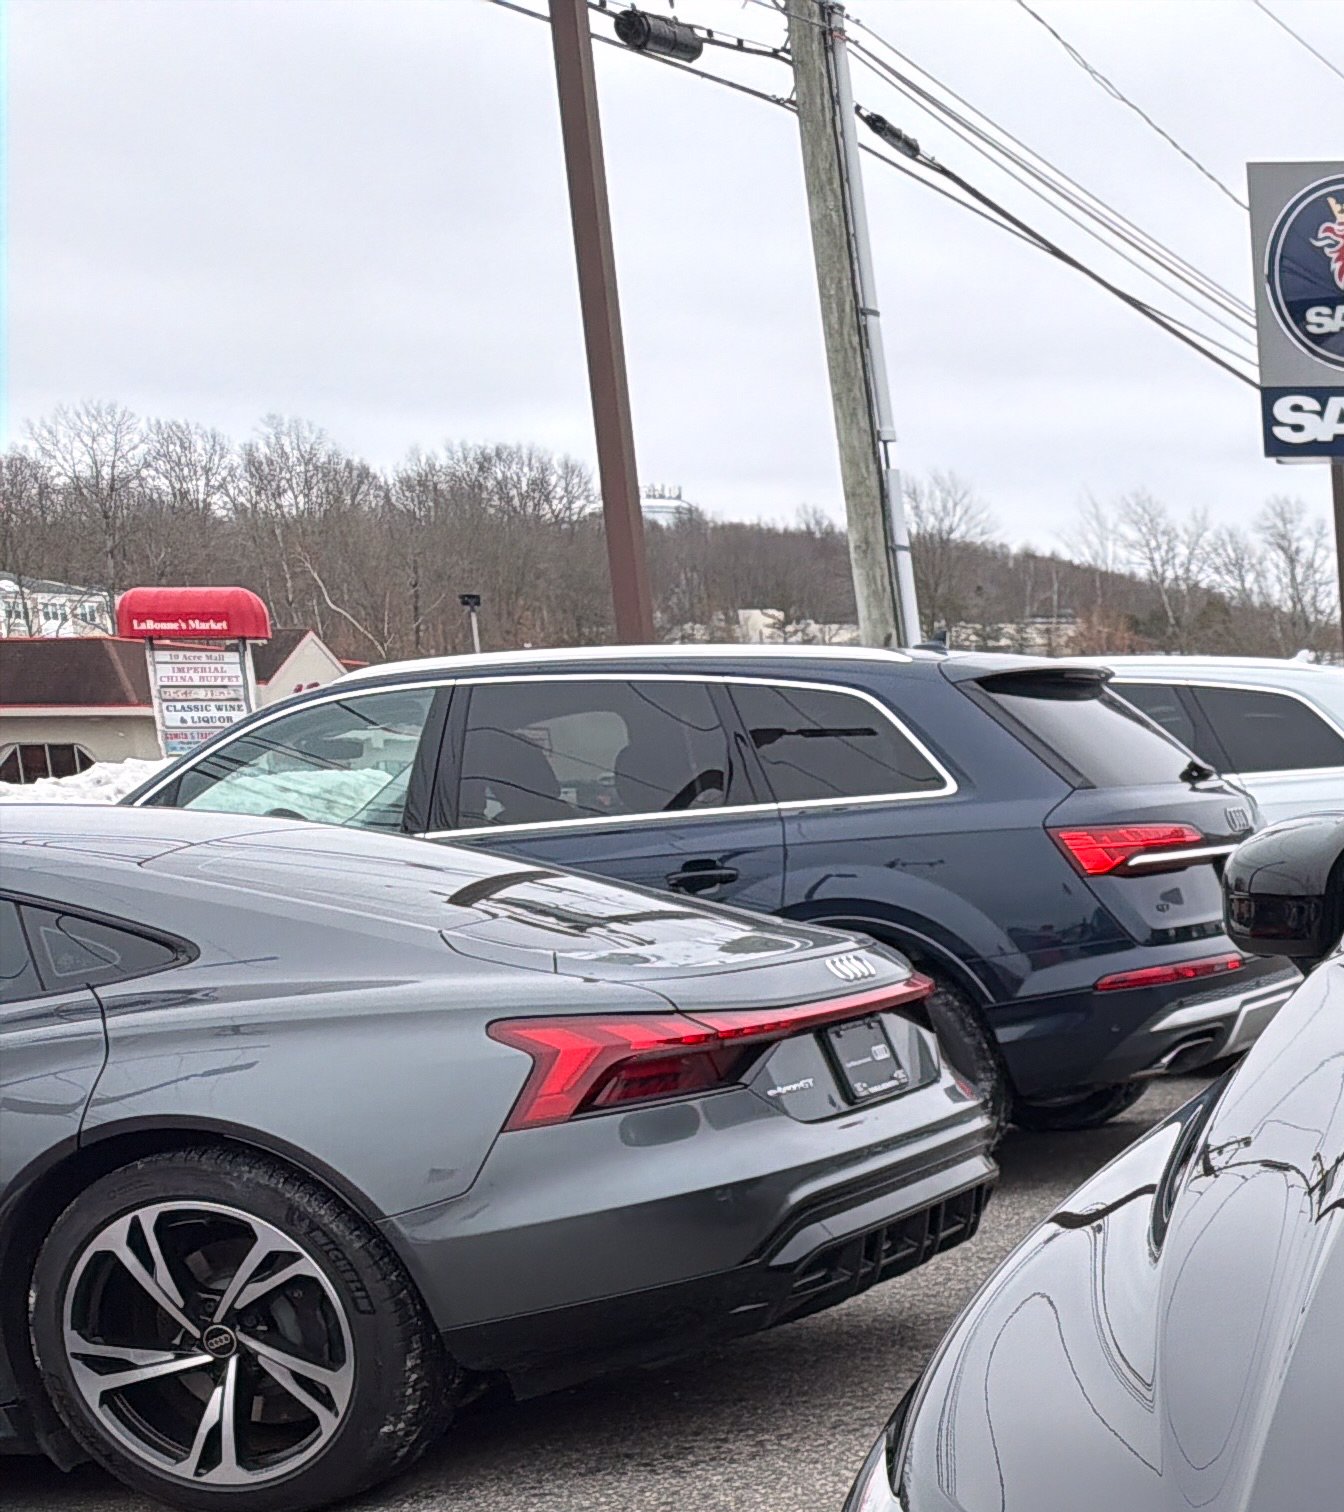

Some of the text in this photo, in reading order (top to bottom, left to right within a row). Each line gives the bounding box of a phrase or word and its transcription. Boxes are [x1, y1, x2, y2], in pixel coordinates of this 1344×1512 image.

[132, 619, 228, 631] LaBonne's Market
[181, 653, 204, 661] Acre
[204, 653, 225, 662] Mall
[171, 666, 228, 674] IMPERIAL
[159, 675, 241, 683] CHINA BUFFET
[165, 703, 245, 713] CLASSIC WINE
[190, 715, 234, 724] LIQUOR
